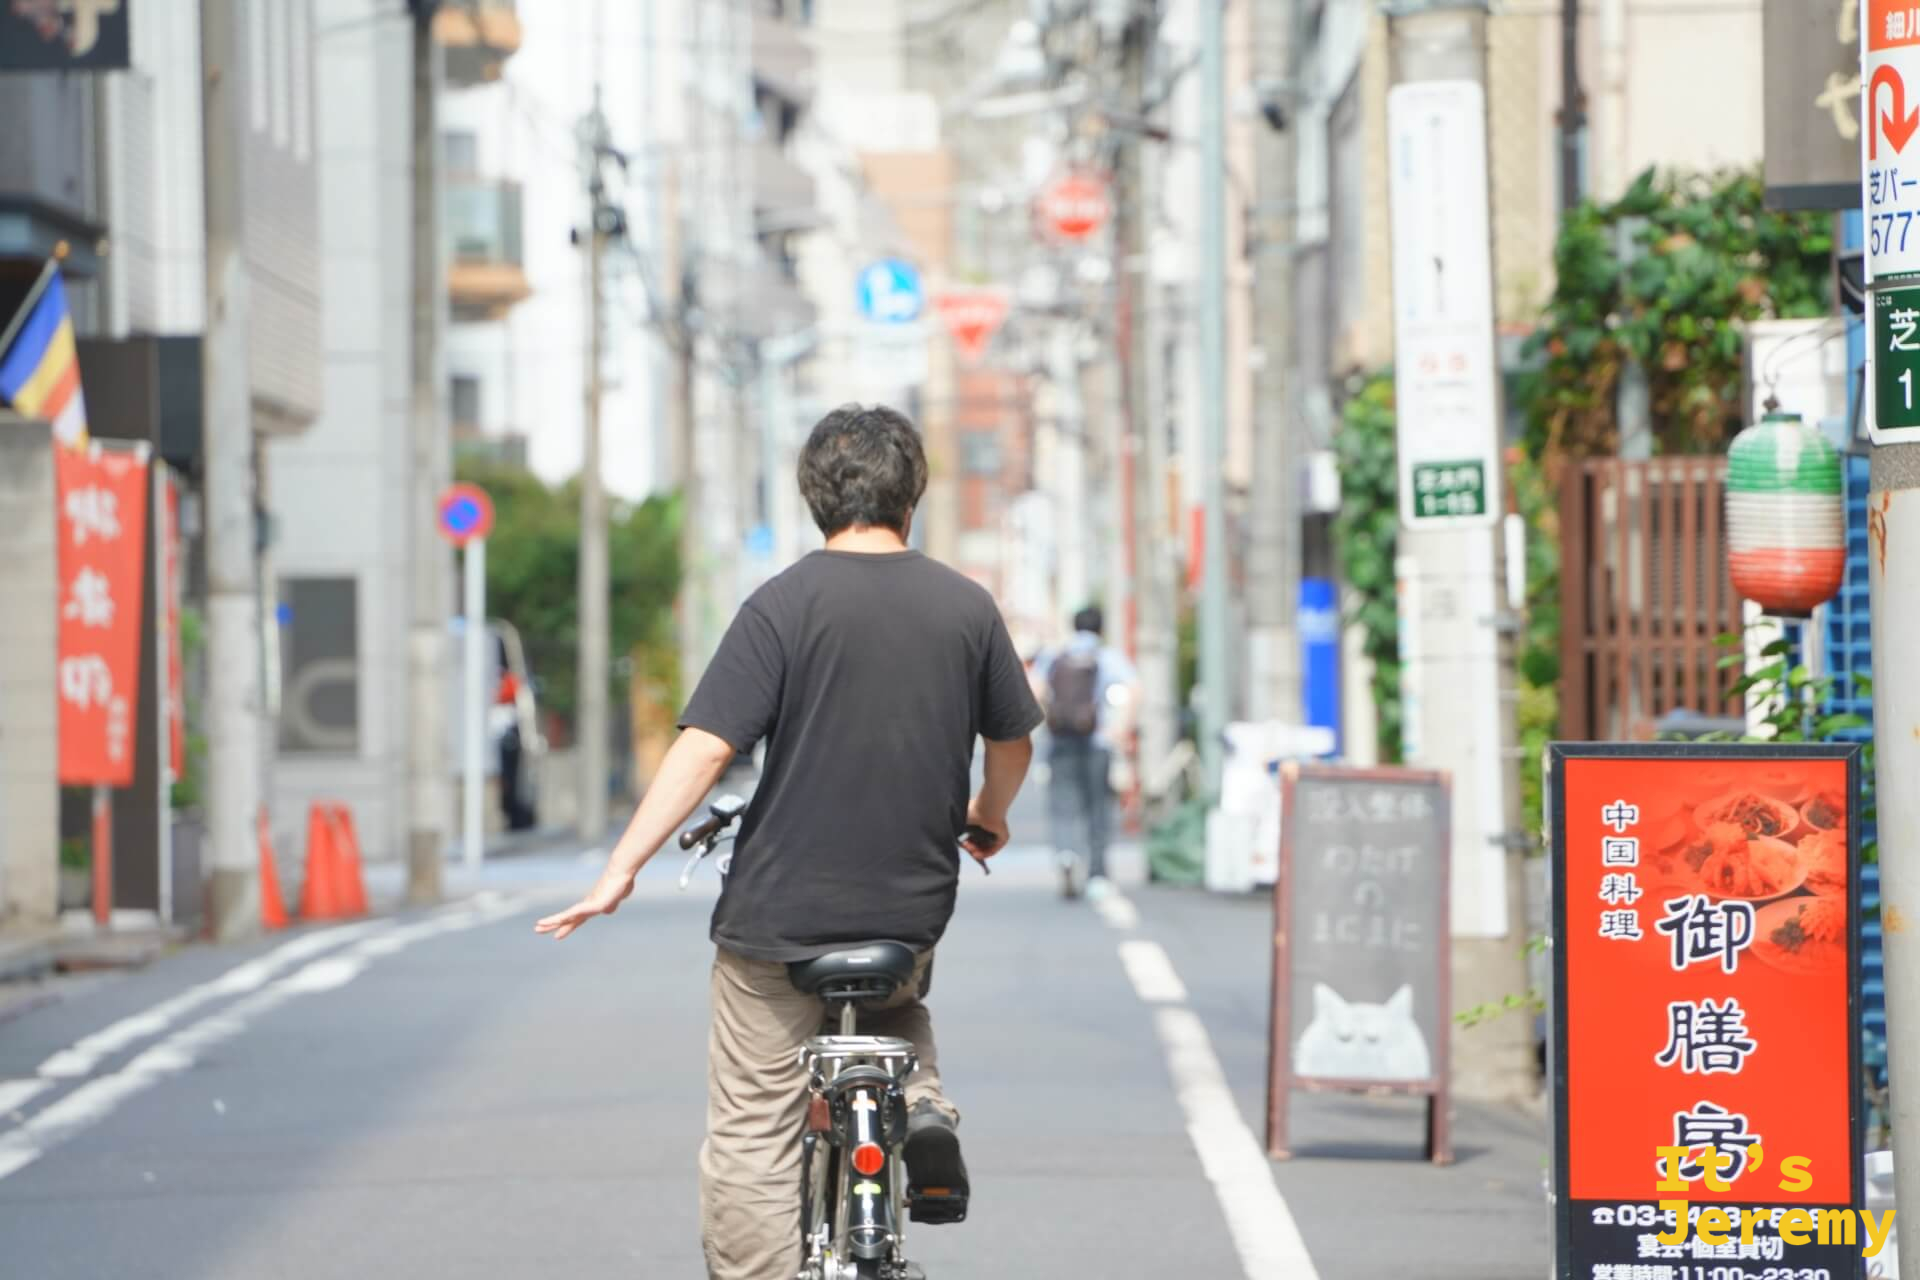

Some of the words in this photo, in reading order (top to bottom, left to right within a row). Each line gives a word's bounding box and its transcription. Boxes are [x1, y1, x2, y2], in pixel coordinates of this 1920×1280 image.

[1870, 210, 1920, 256] 577
[1888, 307, 1920, 352] 芝
[1599, 799, 1644, 943] 中国料理
[1655, 894, 1763, 1184] 御膳房
